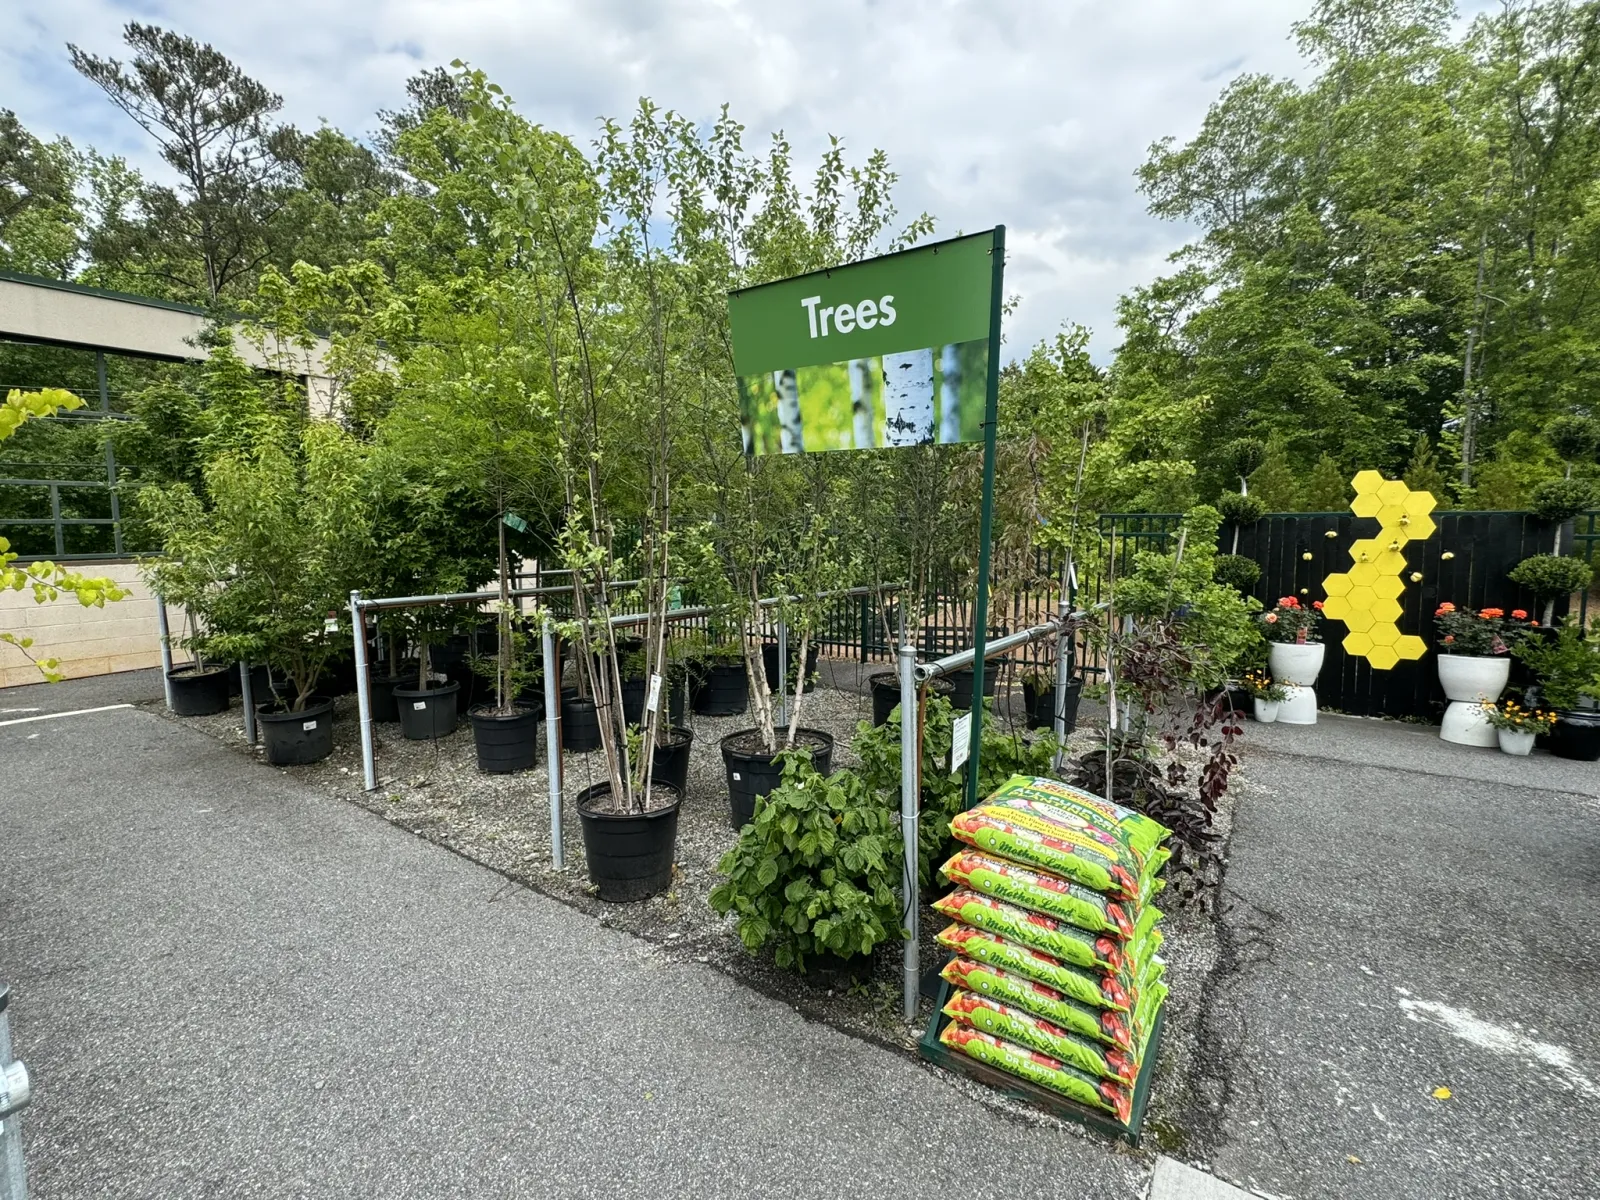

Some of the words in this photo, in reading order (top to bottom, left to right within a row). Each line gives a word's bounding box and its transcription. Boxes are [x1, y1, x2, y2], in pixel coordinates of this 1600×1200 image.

[801, 295, 897, 338] Trees
[1007, 789, 1091, 821] PLANTING
[998, 841, 1040, 862] Mother
[1042, 856, 1078, 875] Land
[1033, 842, 1066, 861] EARTH
[994, 884, 1037, 905] Mother
[1038, 898, 1075, 917] Land
[1028, 885, 1062, 902] EARTH
[1031, 934, 1065, 954] Land
[1023, 953, 1056, 974] EARTH
[1033, 970, 1070, 990] Land
[1024, 988, 1057, 1009] EARTH
[1034, 1005, 1070, 1025] Land
[996, 1022, 1039, 1048] Mother
[1041, 1041, 1074, 1061] Land
[990, 1056, 1032, 1080] Mother
[1036, 1074, 1070, 1093] Land
[1023, 1057, 1056, 1079] EARTH
